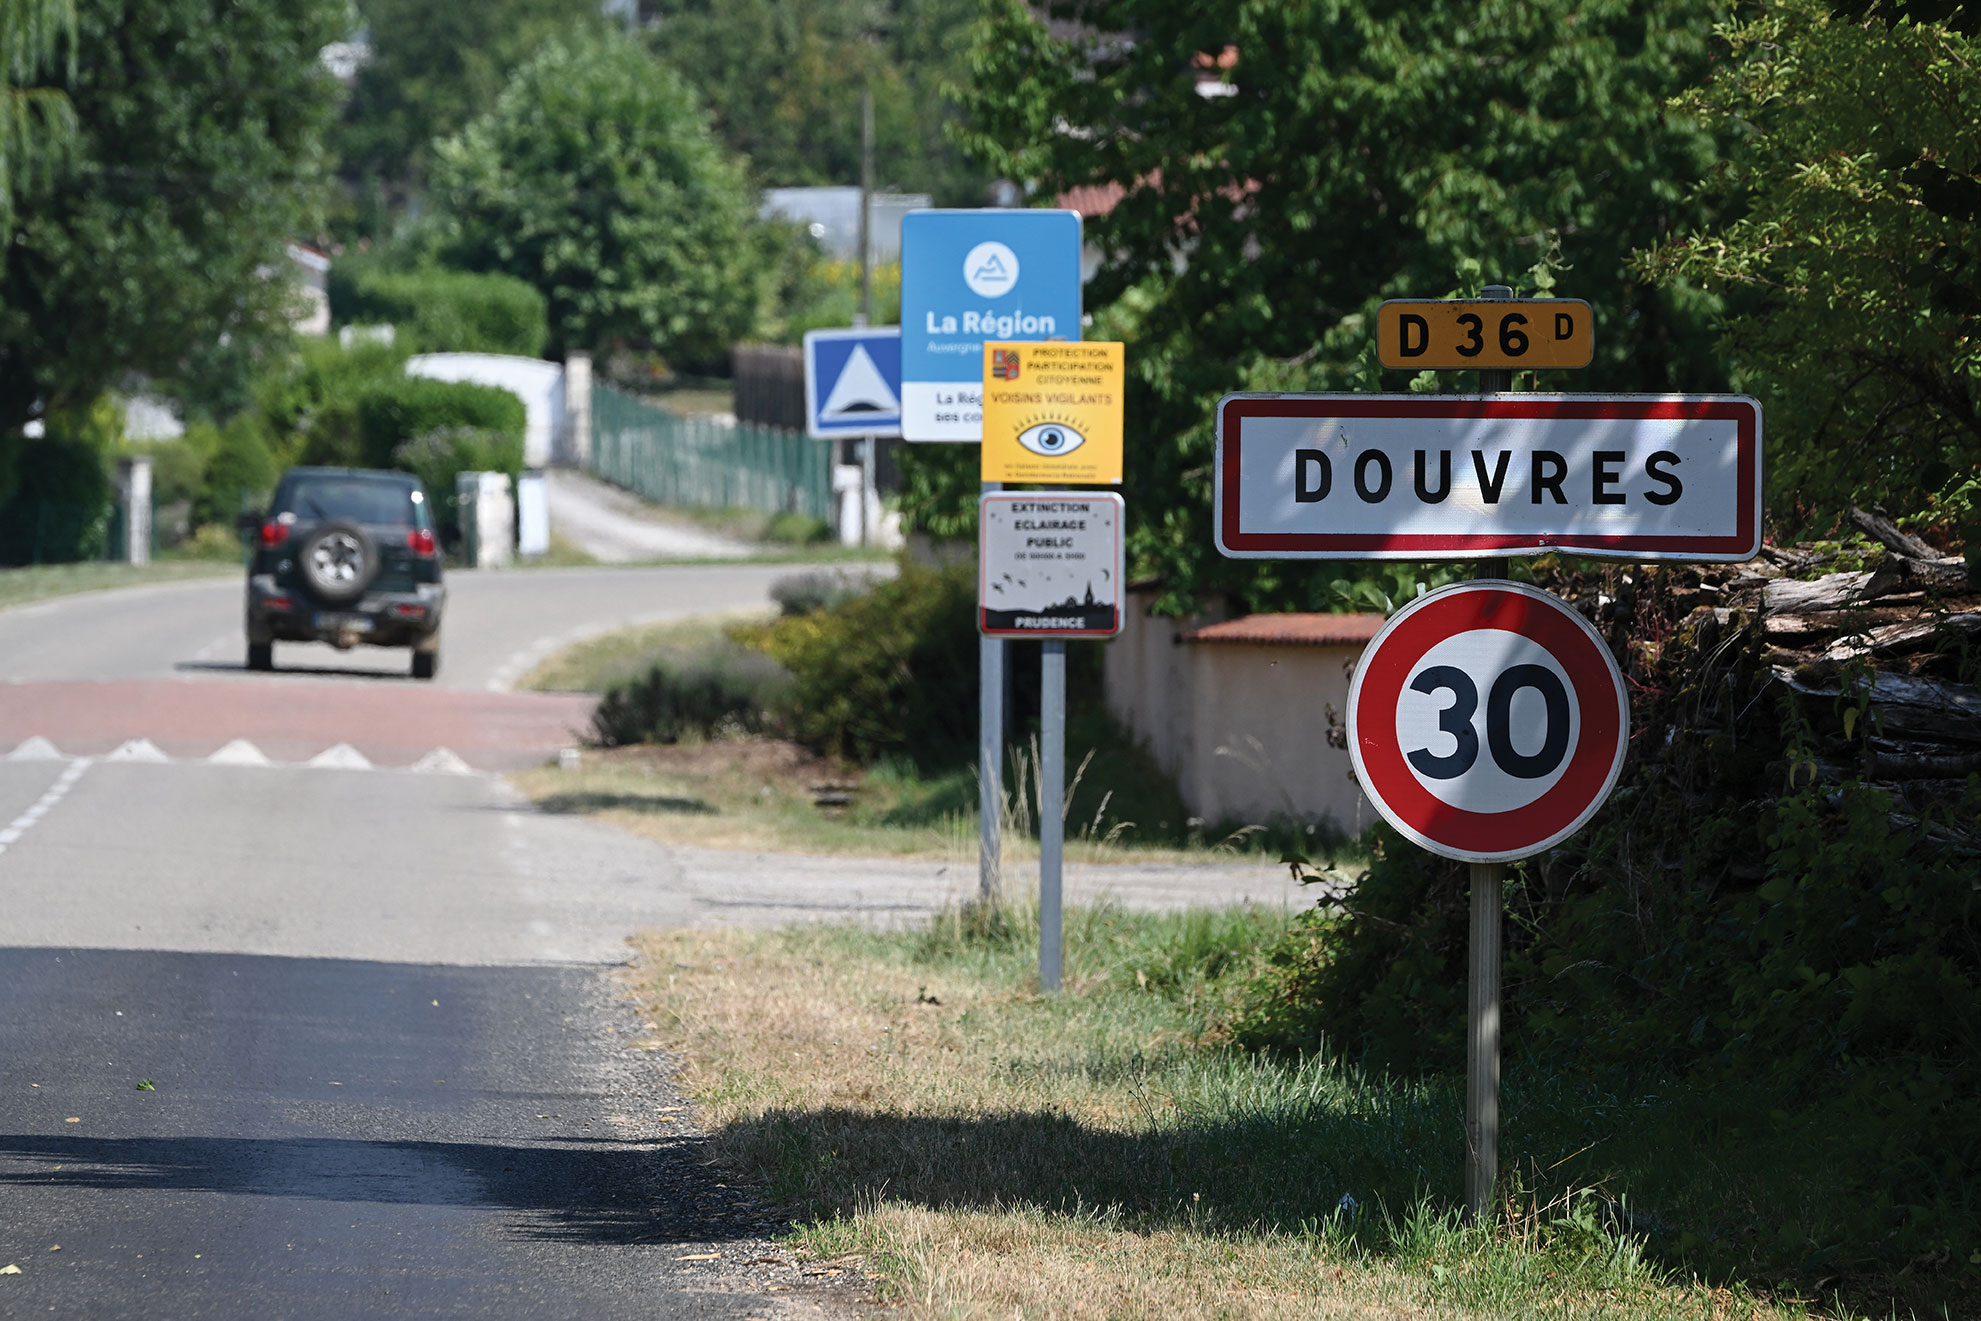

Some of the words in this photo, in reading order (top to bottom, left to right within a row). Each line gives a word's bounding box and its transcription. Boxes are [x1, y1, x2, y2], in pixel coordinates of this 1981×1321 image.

[927, 311, 957, 334] La
[963, 310, 1055, 338] Région
[1400, 314, 1429, 357] D
[1455, 313, 1530, 357] 36
[1555, 313, 1574, 341] D
[1032, 348, 1108, 357] PROTECTION
[1027, 361, 1113, 371] PARTICIPATION
[1036, 375, 1103, 384] CITOYENNE
[957, 391, 983, 406] Rég
[991, 393, 1041, 404] VOISINS
[1045, 393, 1113, 405] VIGILANTS
[1295, 448, 1683, 505] DOUVRES
[1011, 502, 1090, 512] EXTINCTION
[1014, 520, 1086, 530] ECLAIRAGE
[1026, 538, 1073, 547] PUBLIC
[1014, 616, 1086, 628] PRUDENCE
[1406, 664, 1570, 780] 30
